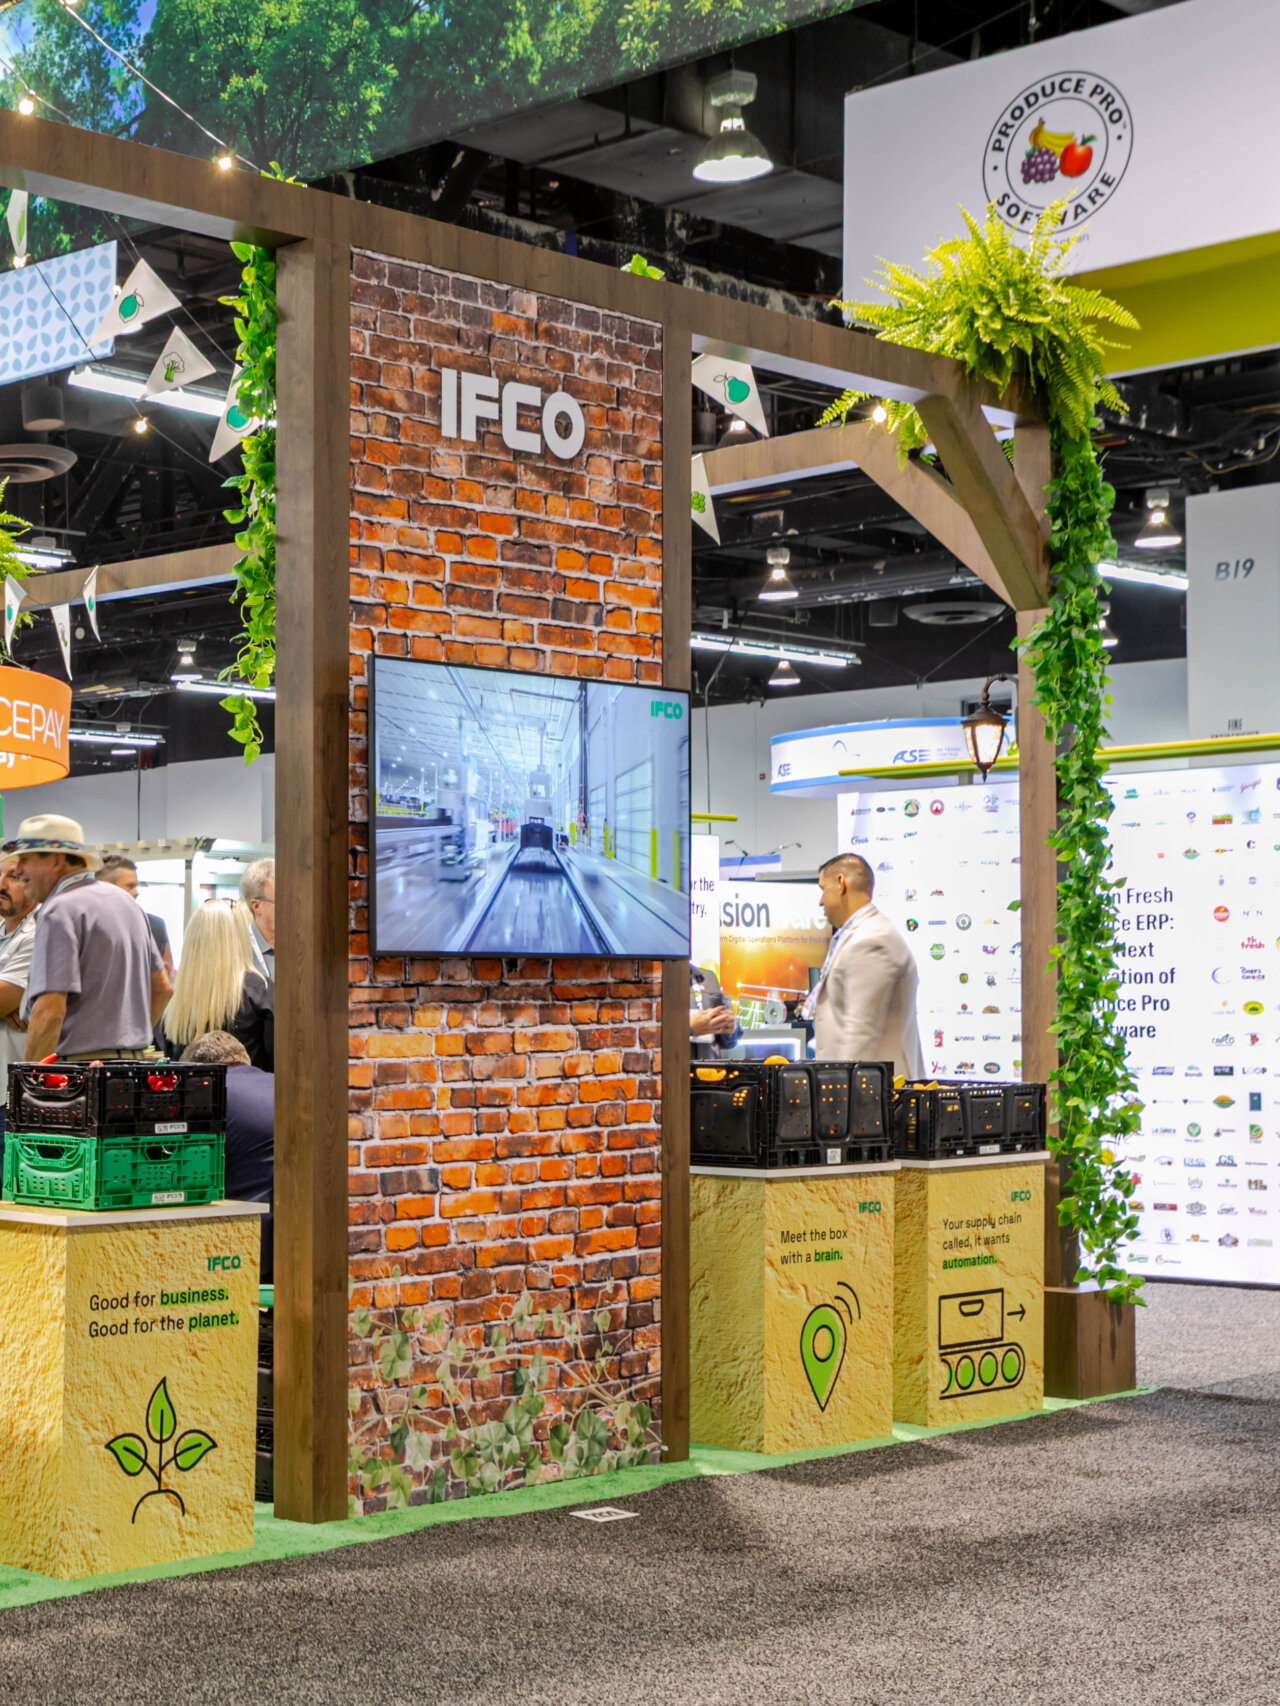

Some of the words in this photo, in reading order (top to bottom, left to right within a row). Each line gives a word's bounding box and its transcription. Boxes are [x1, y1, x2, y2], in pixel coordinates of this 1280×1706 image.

[991, 77, 1086, 153] PRODUCE
[1088, 83, 1124, 124] PRO
[441, 367, 586, 460] IFCO
[650, 700, 684, 720] IFCO
[699, 876, 715, 892] the
[1126, 886, 1174, 905] Fresh
[1113, 918, 1131, 931] ce
[1136, 913, 1175, 931] ERP:
[1158, 967, 1176, 985] of
[1141, 994, 1171, 1012] Pro
[1010, 1190, 1032, 1202] IFCO
[858, 1201, 882, 1214] IFCO
[942, 1217, 964, 1231] Your
[965, 1214, 996, 1230] supply
[998, 1211, 1022, 1226] chain
[780, 1230, 808, 1244] Meet
[809, 1228, 827, 1242] the
[829, 1227, 848, 1241] box
[942, 1236, 973, 1251] called,
[974, 1235, 982, 1247] it
[983, 1232, 1011, 1246] wants
[207, 1255, 242, 1271] IFCO
[780, 1250, 803, 1265] with
[805, 1253, 812, 1263] a
[814, 1247, 844, 1262] brain.
[942, 1253, 998, 1270] automation.
[89, 1291, 129, 1311] Good
[134, 1291, 156, 1307] for
[160, 1287, 229, 1306] business.
[89, 1318, 128, 1338] Good
[133, 1317, 156, 1334] for
[159, 1315, 185, 1331] the
[188, 1310, 239, 1333] planet.
